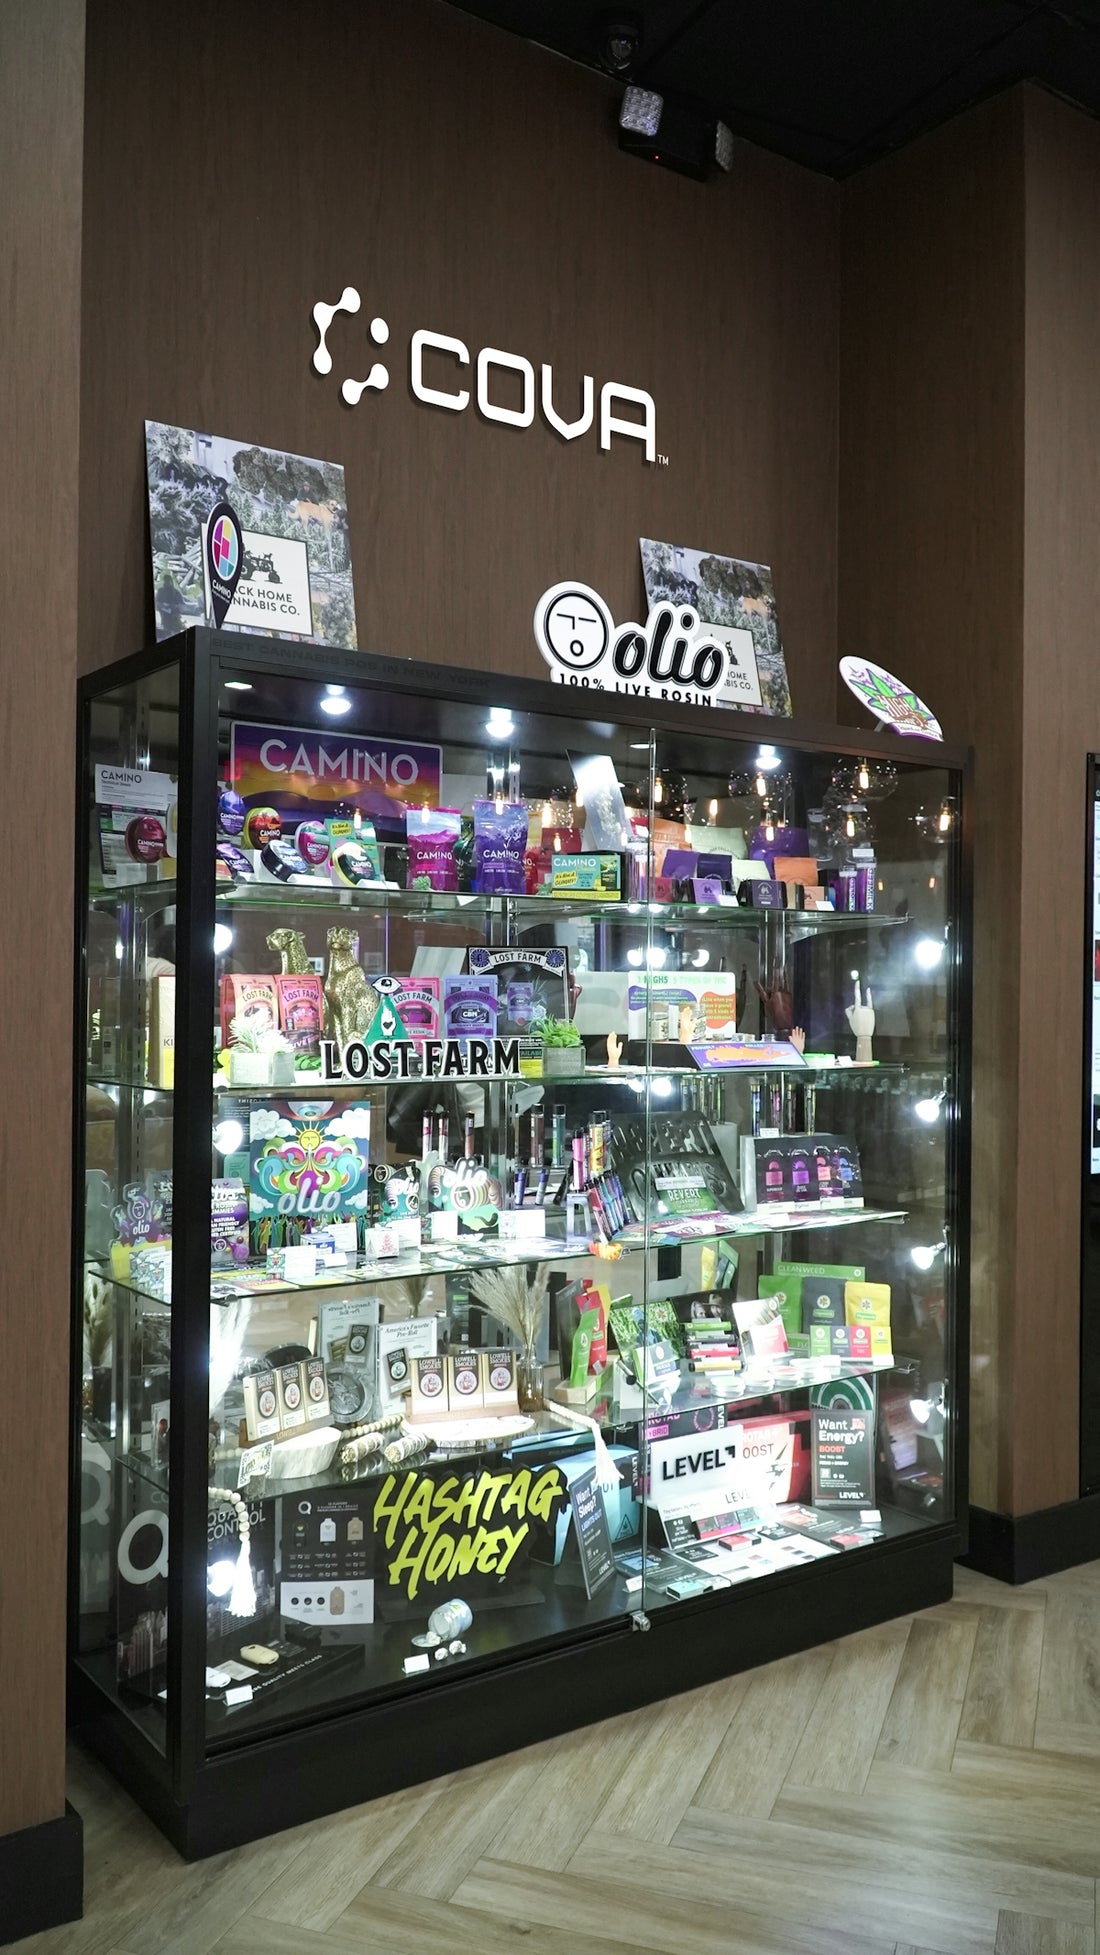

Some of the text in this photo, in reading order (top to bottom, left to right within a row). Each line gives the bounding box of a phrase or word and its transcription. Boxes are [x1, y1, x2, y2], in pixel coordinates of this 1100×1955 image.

[411, 329, 656, 462] COVA
[257, 589, 293, 603] HOME
[231, 597, 300, 616] NNABIS CO.
[612, 609, 724, 690] olio
[212, 638, 253, 651] BEST
[260, 644, 340, 665] CANNABIS
[382, 662, 398, 675] IN
[403, 665, 441, 681] NEW
[448, 672, 491, 688] YORK
[560, 673, 711, 707] 100% LIVE ROSIN
[260, 738, 419, 786] CAMINO
[101, 770, 142, 784] CAMINO
[416, 851, 453, 860] CAMINO
[483, 849, 520, 860] CAMINO
[553, 858, 597, 867] CAMINO
[494, 952, 542, 964] LOST FARM
[242, 990, 258, 1002] LOST
[284, 990, 319, 1002] LOST FARM
[394, 993, 411, 1004] LOST
[412, 992, 433, 1004] FARM
[322, 1039, 521, 1078] LOST FARM
[277, 1177, 342, 1214] olio
[667, 1188, 702, 1201] REVERT
[132, 1220, 150, 1235] olio
[385, 1322, 429, 1334] America's Favorite
[818, 1419, 848, 1430] Want
[818, 1430, 865, 1445] Energy?
[742, 1443, 775, 1459] OOST
[818, 1445, 846, 1453] BOOST
[631, 1456, 639, 1484] LEVEL
[662, 1448, 726, 1481] LEVEL
[576, 1487, 591, 1505] Want
[839, 1491, 861, 1499] LEVEL
[373, 1469, 564, 1550] HASHTAG
[578, 1495, 597, 1518] Sleep?
[208, 1508, 266, 1543] CONTOL
[388, 1522, 530, 1601] HONEY
[304, 1655, 323, 1665] CLASS
